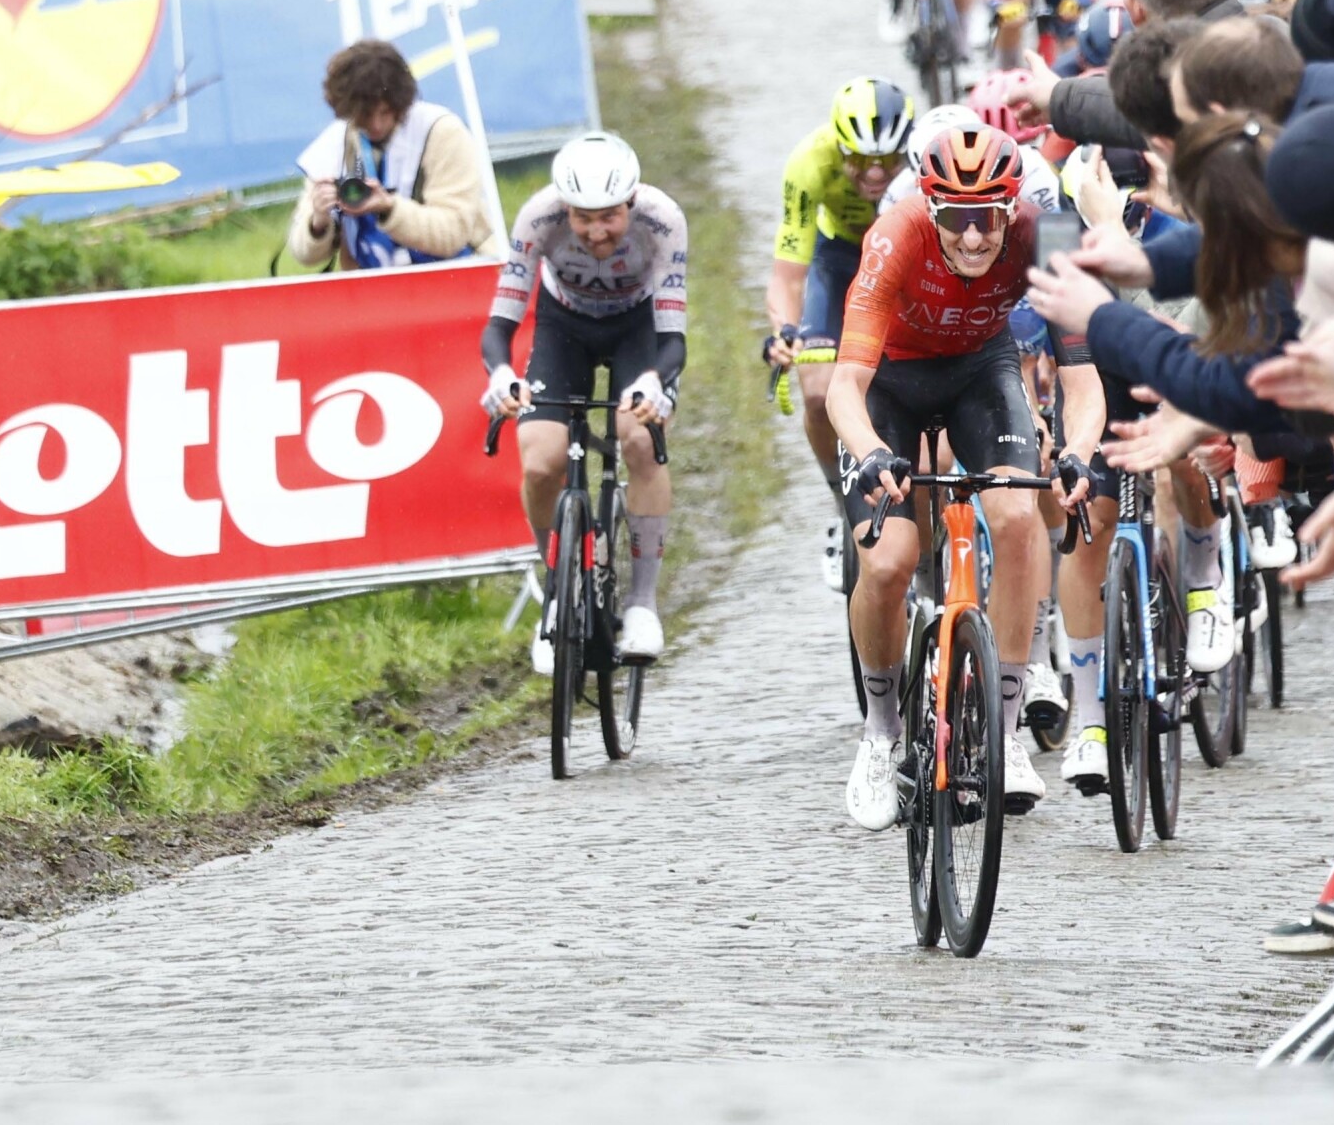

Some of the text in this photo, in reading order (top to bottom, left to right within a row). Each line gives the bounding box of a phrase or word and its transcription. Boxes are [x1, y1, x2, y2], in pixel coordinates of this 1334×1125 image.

[849, 231, 894, 312] INEOS
[920, 279, 946, 297] GOBIK
[905, 298, 1015, 326] INEOS
[997, 434, 1027, 446] GOBIK
